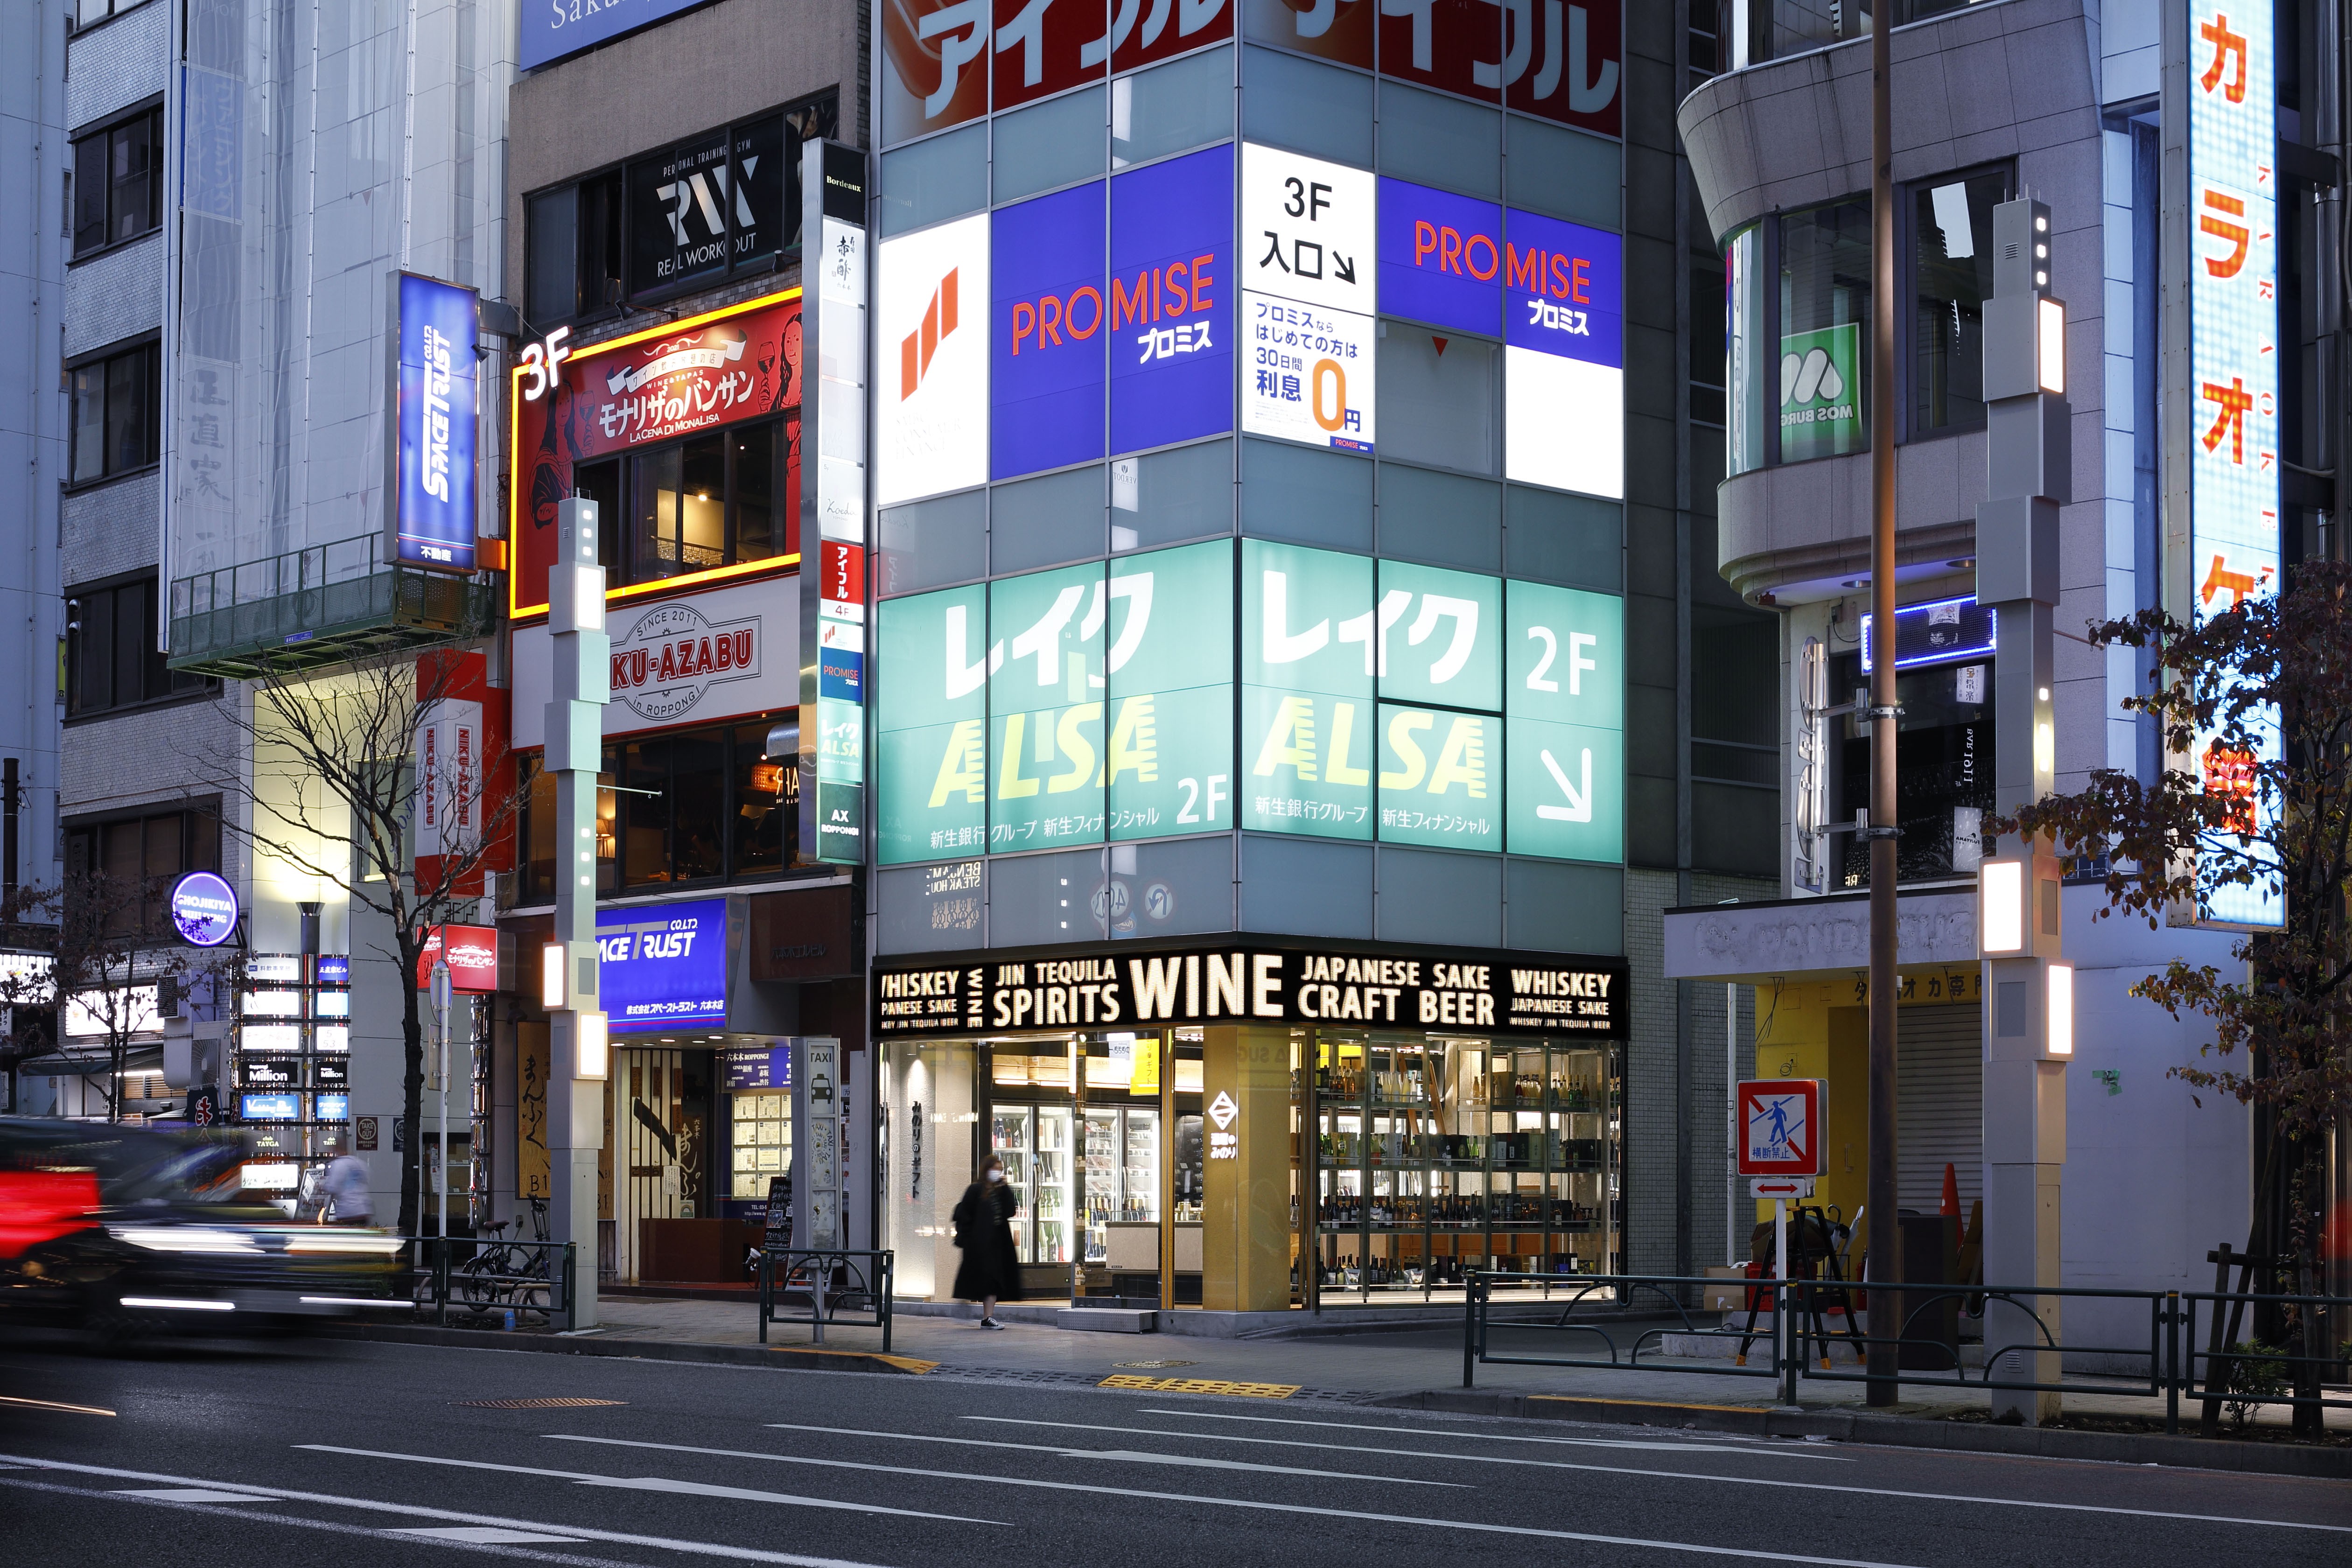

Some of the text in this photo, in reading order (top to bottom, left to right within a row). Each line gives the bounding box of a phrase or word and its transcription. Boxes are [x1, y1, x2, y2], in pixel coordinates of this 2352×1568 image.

[663, 139, 751, 177] PERONAL TRAINING GYM
[826, 175, 861, 192] Bordeaux
[1284, 176, 1332, 222] 3F
[658, 254, 683, 277] REAL
[837, 235, 851, 280] 赤酢
[1260, 231, 1323, 280] 入口
[1415, 220, 1590, 304] PROMISE
[1013, 253, 1214, 356] PROMISE
[1256, 302, 1334, 333] プロミスなら
[1527, 298, 1590, 336] プロミス
[667, 344, 680, 353] 2021
[1137, 320, 1213, 364] プロミス
[1256, 323, 1358, 358] はじめての方は
[2257, 162, 2277, 531] KARAOKE
[520, 325, 572, 401] 3F
[1256, 347, 1302, 372] 30日間
[646, 369, 704, 390] WINE&TAPAS
[1257, 369, 1302, 402] 利息
[599, 370, 755, 438] モナリザのバンサン
[190, 369, 232, 502] 正直家
[630, 433, 641, 443] LA
[641, 427, 664, 440] CENA
[664, 425, 675, 436] DI
[1336, 439, 1358, 449] PROMISE
[420, 545, 452, 562] 不動産
[837, 546, 848, 599] アイフル
[637, 610, 697, 637] SINCE 2011
[835, 605, 849, 616] 4F
[945, 572, 1154, 700] レイク
[1263, 569, 1478, 684] レイク
[824, 665, 859, 680] PROMISE
[1526, 625, 1596, 696] 2F
[845, 678, 859, 687] プロミス
[633, 686, 700, 716] in ROPPONGI
[821, 719, 859, 741] レイク
[821, 739, 859, 758] ALSA
[927, 693, 1159, 809] ALSA
[1253, 695, 1487, 799] ALSA
[426, 728, 435, 826] NIKU-AZABU
[457, 728, 470, 826] NIKU-AZABU
[1176, 774, 1227, 825] 2F
[821, 823, 859, 836] ROPPONGI
[831, 809, 849, 823] AX
[930, 807, 1160, 850] 新生銀行グループ 新生フィナンシャル
[1254, 795, 1491, 835] 新生銀行グループ 新生フィナンシャル
[177, 894, 232, 912] SHOJIKIYA
[627, 921, 696, 960] TRUST
[771, 943, 826, 960] 六本木エルビル
[319, 966, 348, 974] 正直家ビル
[447, 954, 495, 966] モナリザのバンサン
[996, 958, 1117, 987] JIN TEQUILA
[1301, 955, 1491, 990] JAPANESE SAKE
[967, 968, 983, 1028] WINE
[1129, 953, 1284, 1020] WINE
[1511, 968, 1611, 998] WHISKEY
[699, 1000, 724, 1011] 六本木店
[928, 999, 957, 1013] SAKE
[993, 983, 1120, 1027] SPIRITS
[1297, 984, 1495, 1026] CRAFT BEER
[1510, 998, 1609, 1015] JAPANESE SAKE
[910, 1018, 939, 1029] TEQUILA
[941, 1018, 959, 1027] BEER
[1509, 1016, 1543, 1027] WHISKEY
[1560, 1019, 1590, 1029] TEQUILA
[1592, 1020, 1610, 1029] BEER
[726, 1052, 744, 1062] 六本木
[742, 1064, 753, 1073] 銀座
[811, 1052, 832, 1063] TAXI
[249, 1069, 288, 1081] Million
[759, 1069, 769, 1078] 赤坂
[522, 1053, 545, 1150] まんぷく
[911, 1101, 922, 1199] みのりのギフト
[1210, 1146, 1237, 1159] みのり
[1752, 1146, 1791, 1161] 横断禁止
[530, 1174, 547, 1192] B1
